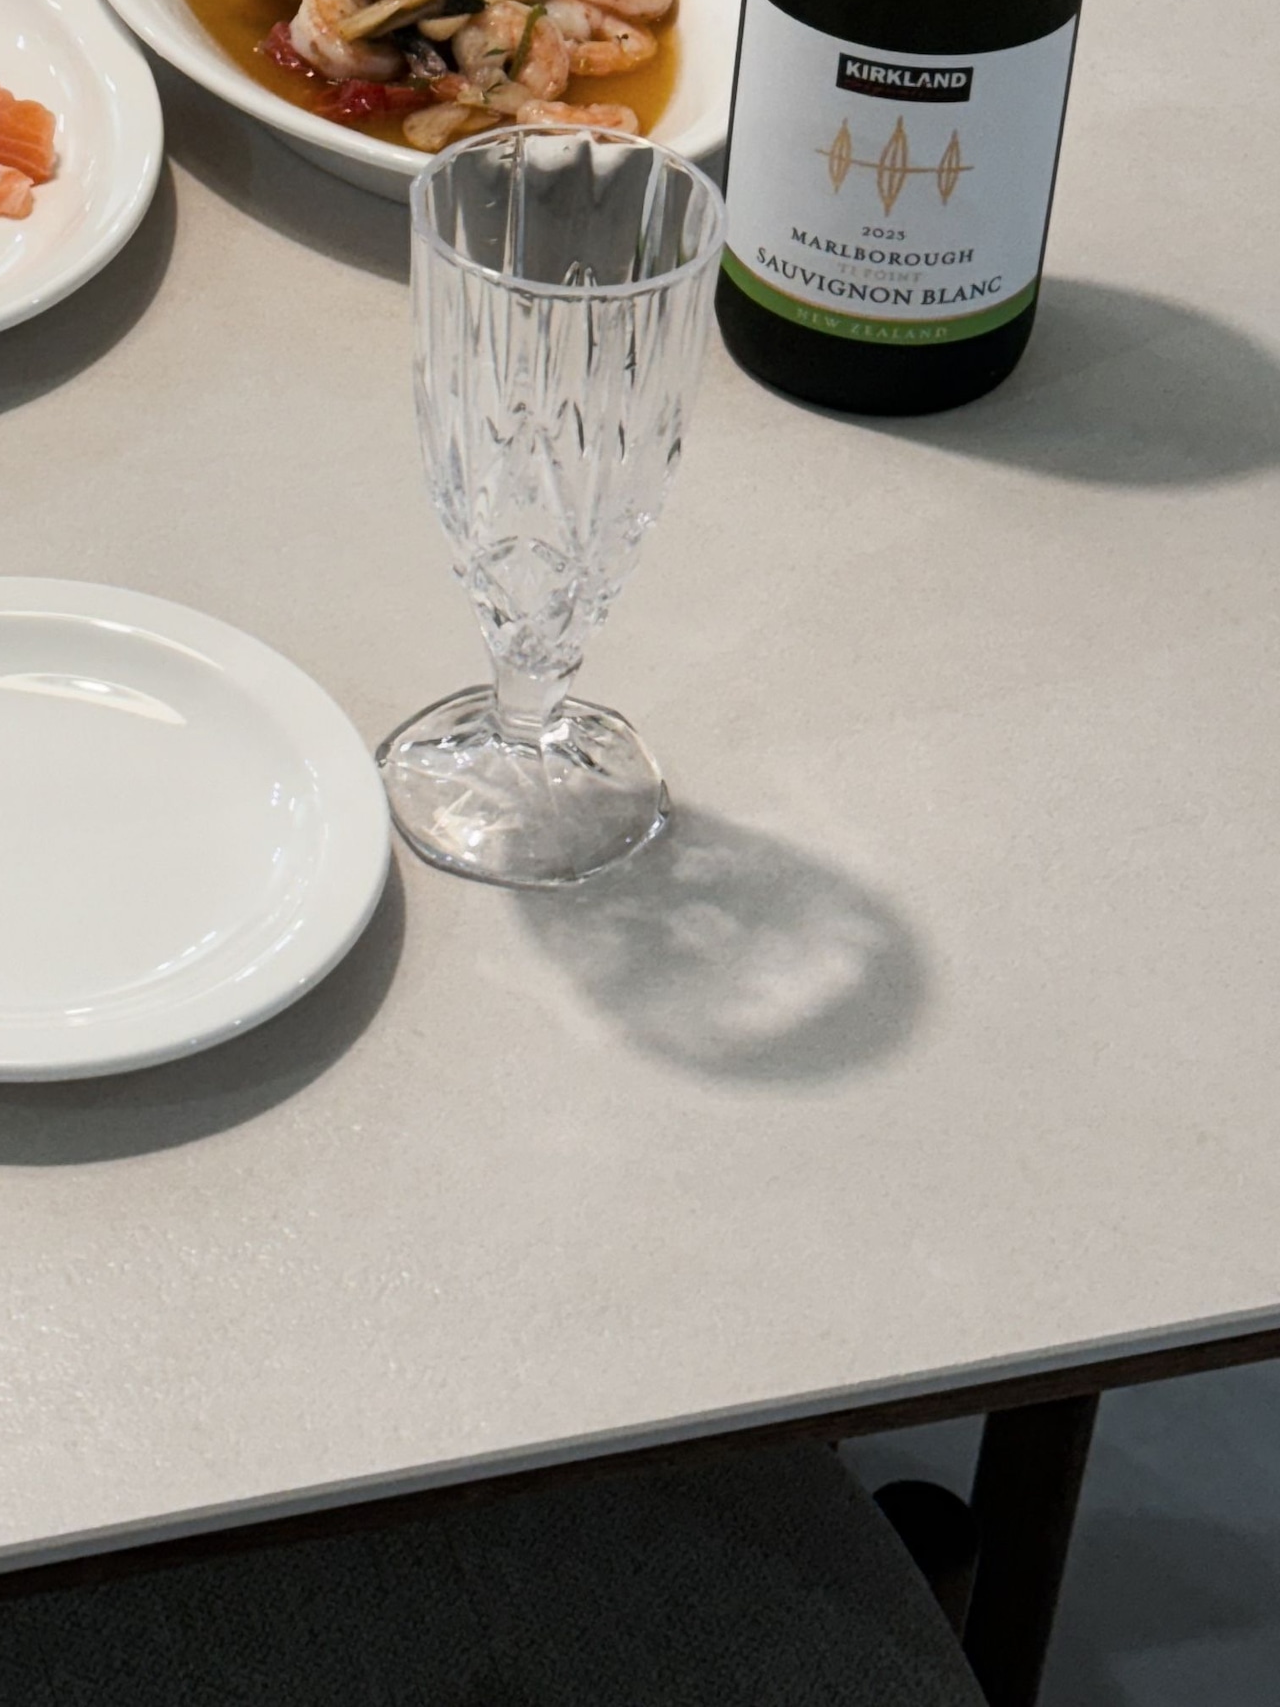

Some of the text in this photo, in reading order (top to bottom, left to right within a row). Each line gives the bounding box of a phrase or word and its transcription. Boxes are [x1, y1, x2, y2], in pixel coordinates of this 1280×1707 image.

[845, 60, 967, 88] KIRKLAND
[791, 227, 975, 266] MARLBOROUGH
[756, 247, 1002, 305] SAUVIGNON BLANC
[796, 308, 948, 339] NEW ZEALAND
